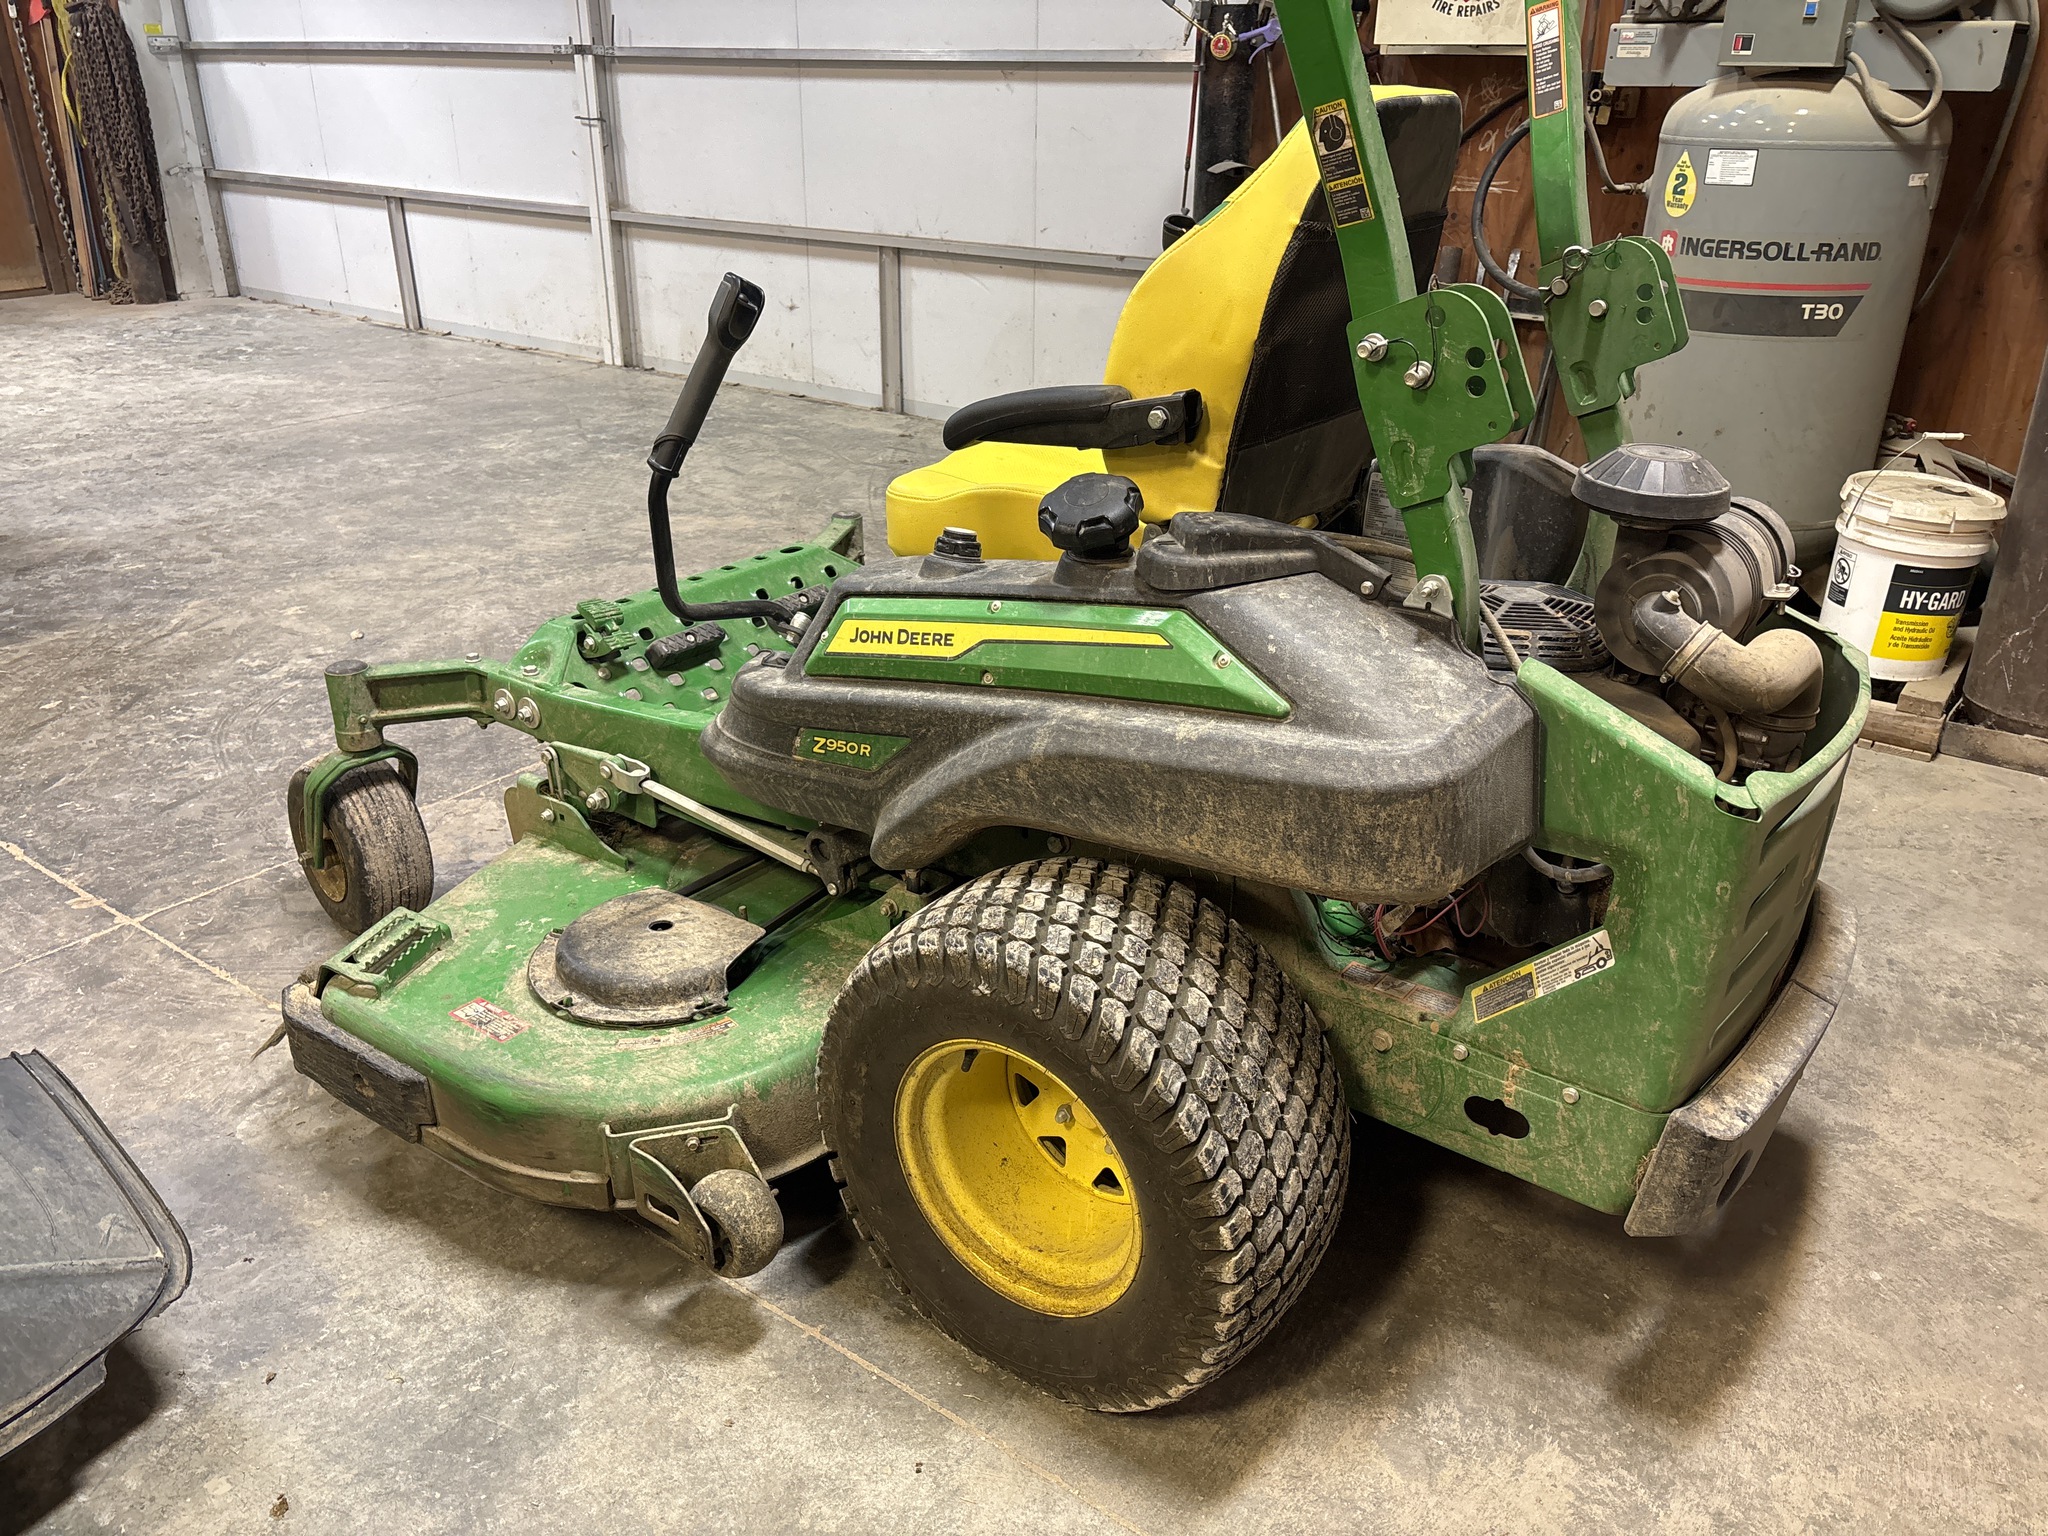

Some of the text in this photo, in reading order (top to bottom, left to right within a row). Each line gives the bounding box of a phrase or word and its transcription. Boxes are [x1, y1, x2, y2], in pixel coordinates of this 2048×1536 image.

[1432, 0, 1501, 17] TIRE REPAIRS
[1535, 1, 1559, 14] WARNING
[1315, 101, 1343, 115] CAUTION
[1332, 177, 1363, 190] ATENCIÓN
[1672, 173, 1688, 196] 2
[1666, 200, 1689, 211] Warranty
[1680, 236, 1882, 261] INGERSOLL-RAND
[1801, 303, 1844, 320] T30
[1899, 589, 1966, 611] HY-GARD
[1895, 618, 1929, 627] Transmission
[849, 627, 955, 647] JOHN DEERE
[1889, 634, 1908, 642] Aceite
[1488, 969, 1522, 990] ATENCIÓN
